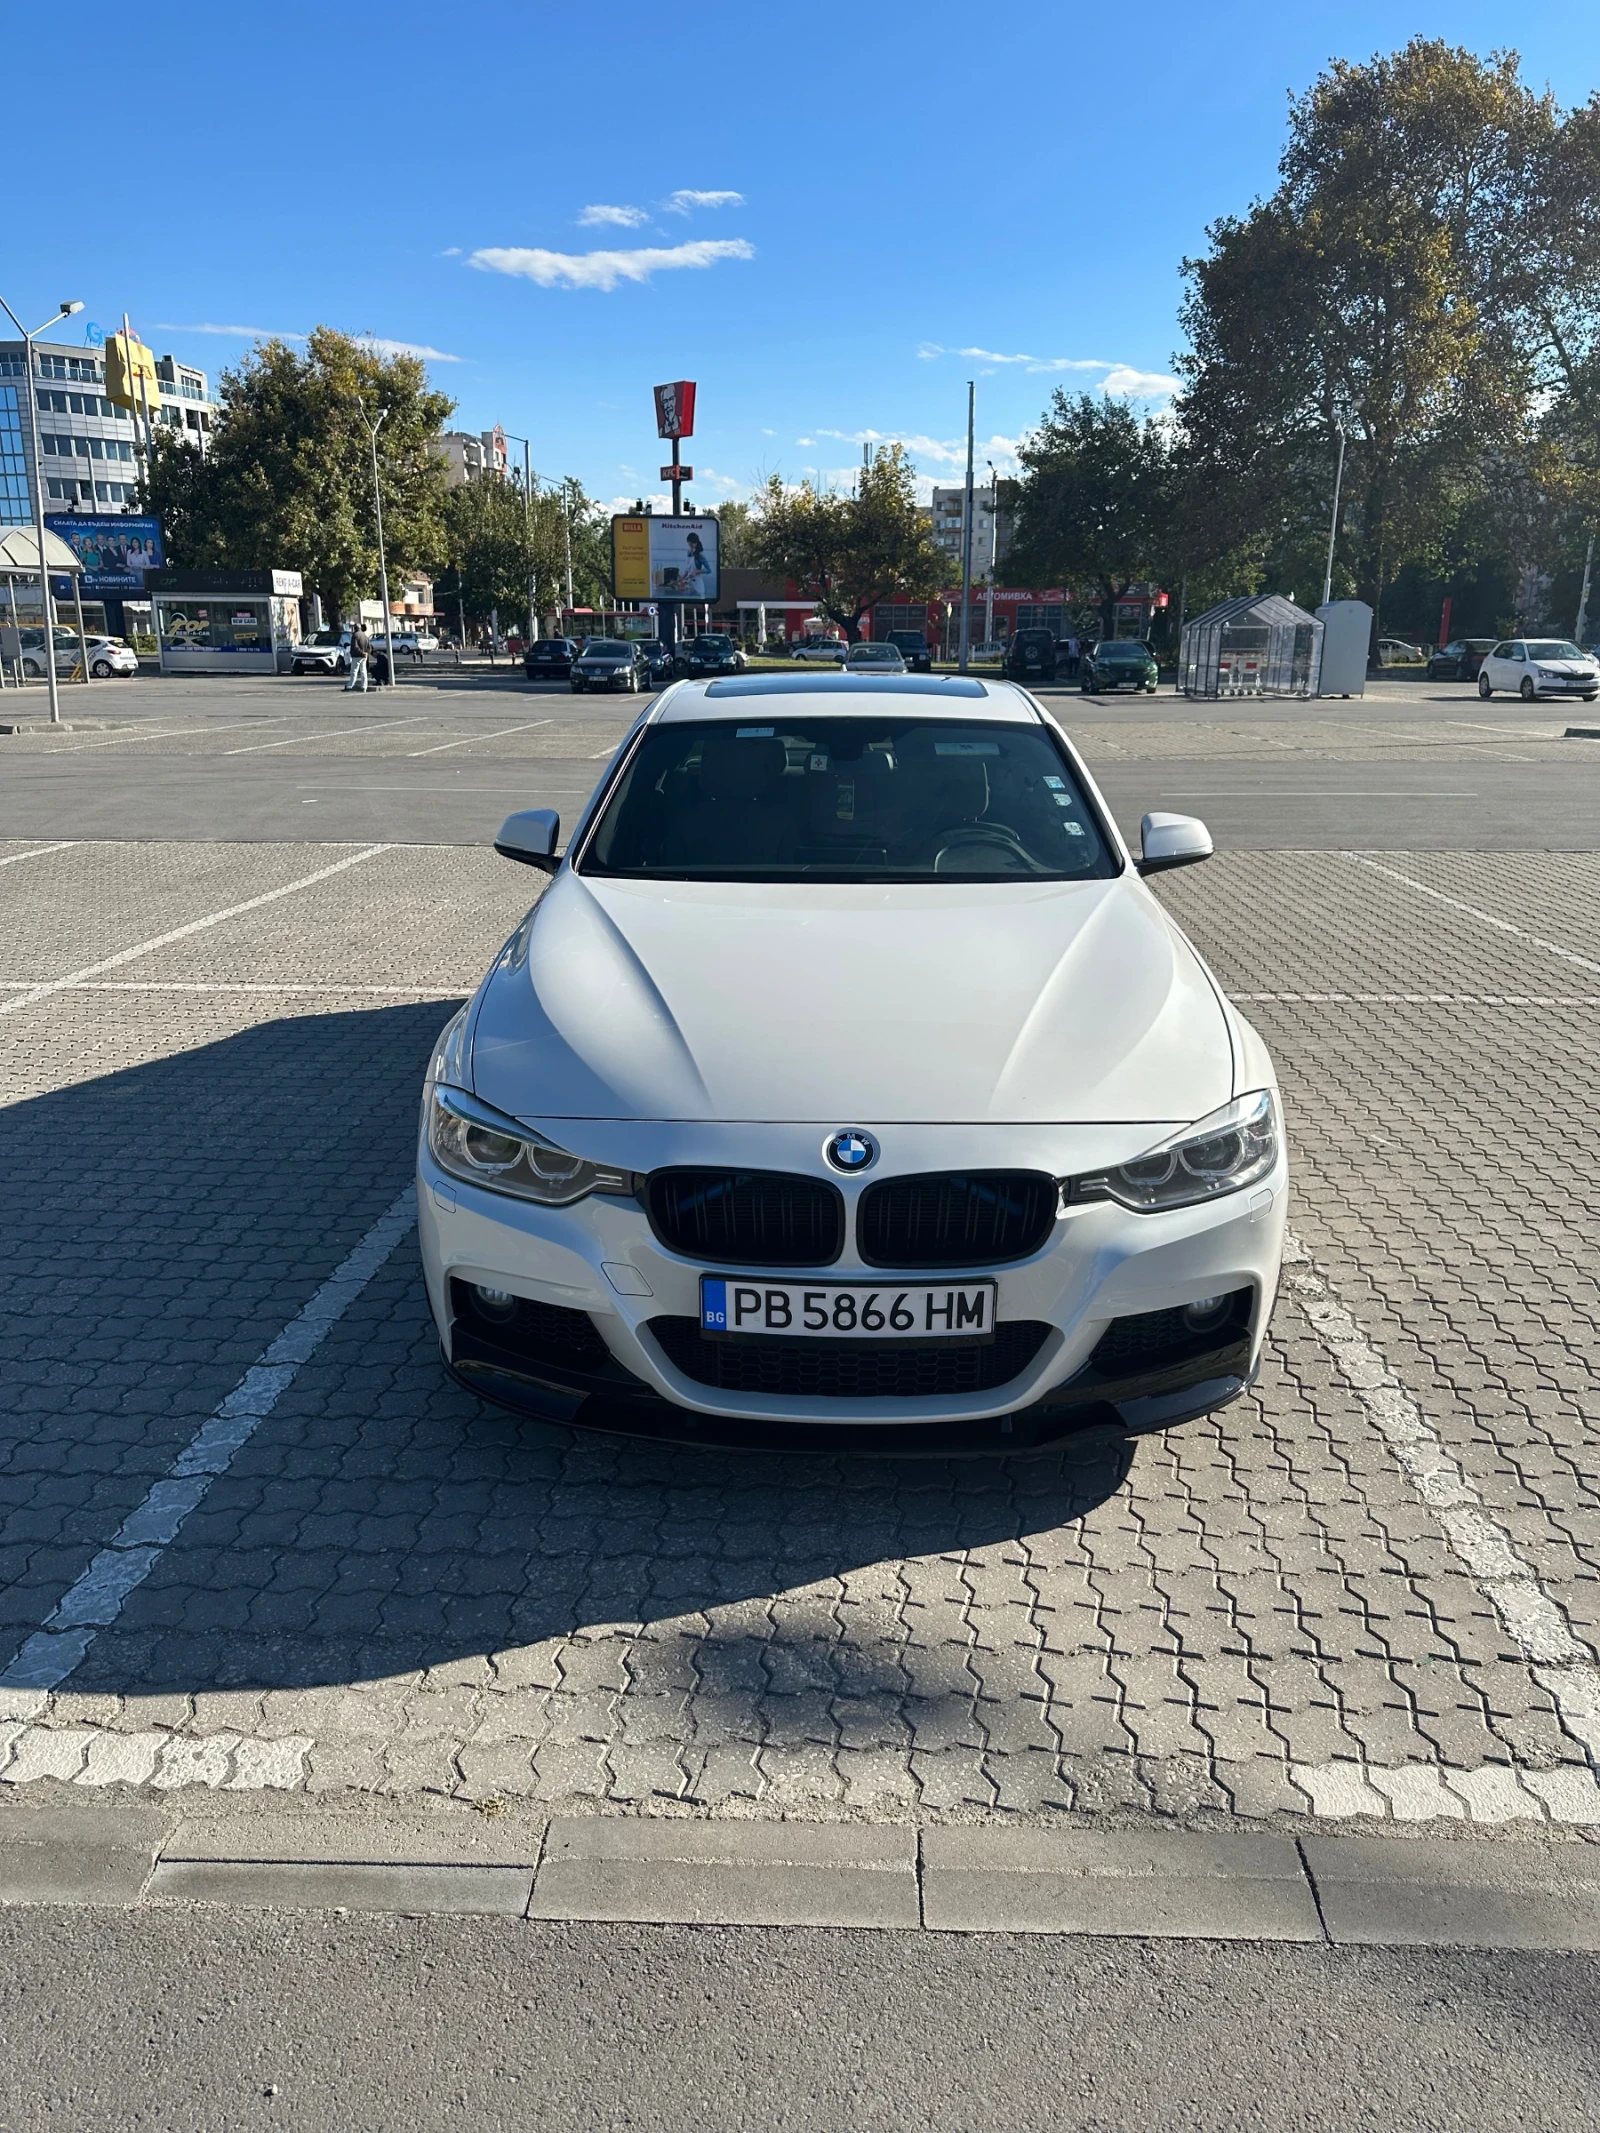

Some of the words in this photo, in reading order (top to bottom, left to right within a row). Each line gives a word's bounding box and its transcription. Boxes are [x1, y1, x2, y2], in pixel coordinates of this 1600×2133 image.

[662, 468, 676, 478] KFC
[976, 592, 1033, 600] АВОМИВКА
[168, 619, 210, 637] TOP
[833, 1133, 870, 1146] BMW
[734, 1288, 792, 1329] PB
[803, 1292, 914, 1331] 5866
[925, 1291, 985, 1330] HM
[706, 1310, 725, 1323] BG
